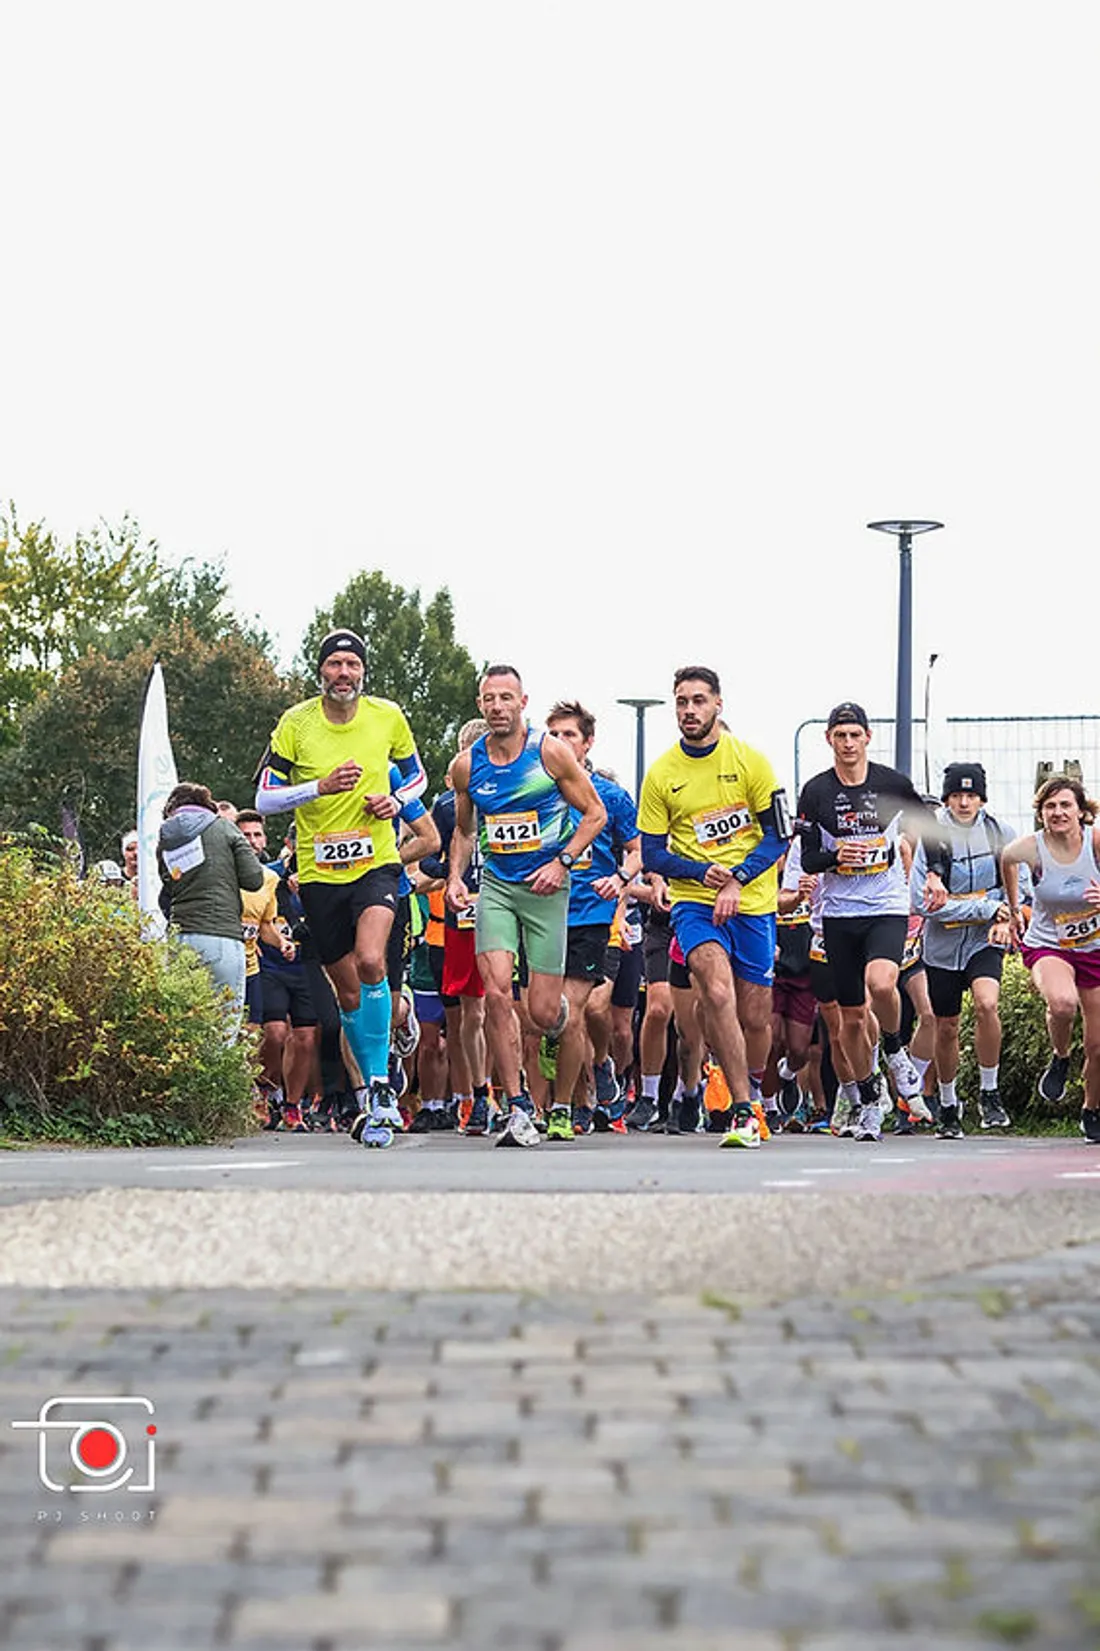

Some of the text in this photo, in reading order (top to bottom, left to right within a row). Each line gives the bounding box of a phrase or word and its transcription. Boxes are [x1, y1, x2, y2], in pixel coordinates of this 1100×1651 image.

[837, 811, 877, 821] NORTH
[837, 820, 859, 830] RUN
[852, 825, 879, 834] TEAM
